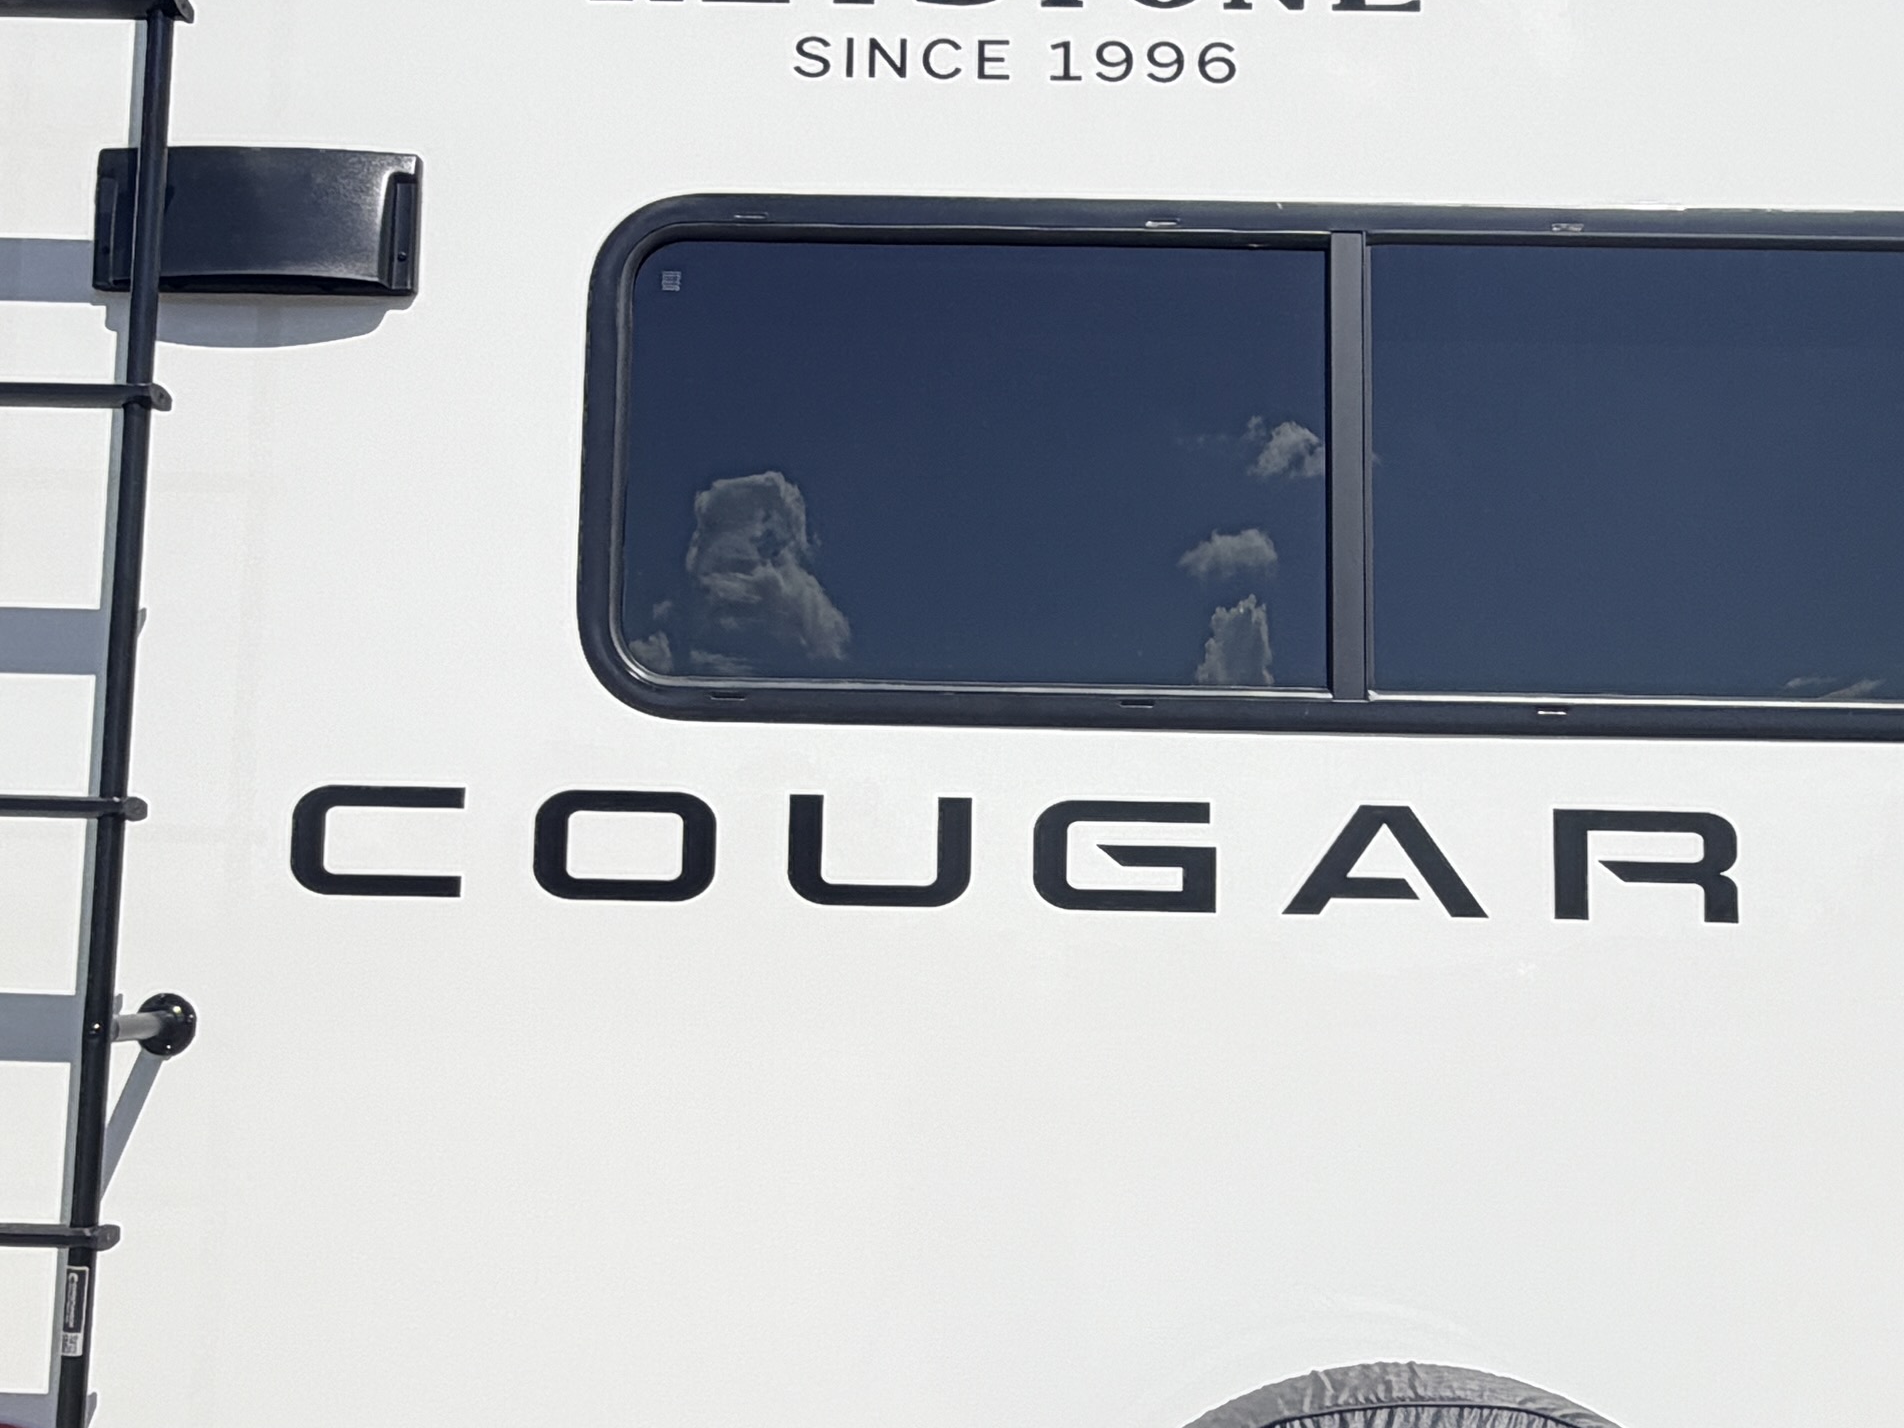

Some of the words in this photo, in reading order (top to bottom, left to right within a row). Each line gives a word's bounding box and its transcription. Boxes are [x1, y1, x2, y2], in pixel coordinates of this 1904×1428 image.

[793, 36, 1010, 80] SINCE
[1050, 40, 1236, 84] 1996
[290, 784, 1739, 924] COUGAR
